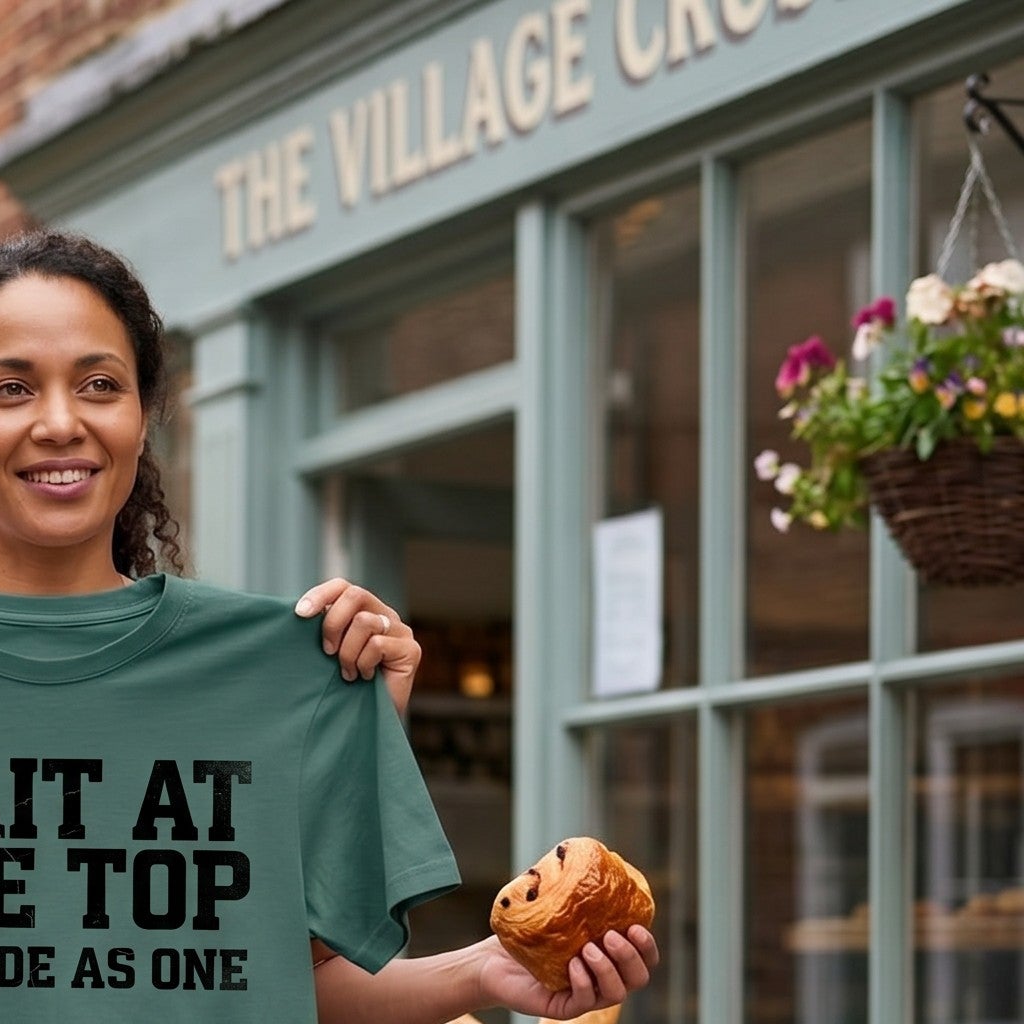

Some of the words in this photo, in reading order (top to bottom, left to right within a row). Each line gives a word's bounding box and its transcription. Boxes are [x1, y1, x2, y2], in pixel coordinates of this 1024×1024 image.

[215, 126, 317, 261] THE
[329, 0, 595, 209] VILLAGE
[132, 760, 252, 842] AT
[67, 848, 251, 931] TOP
[71, 947, 136, 989] AS
[152, 948, 248, 991] ONE
